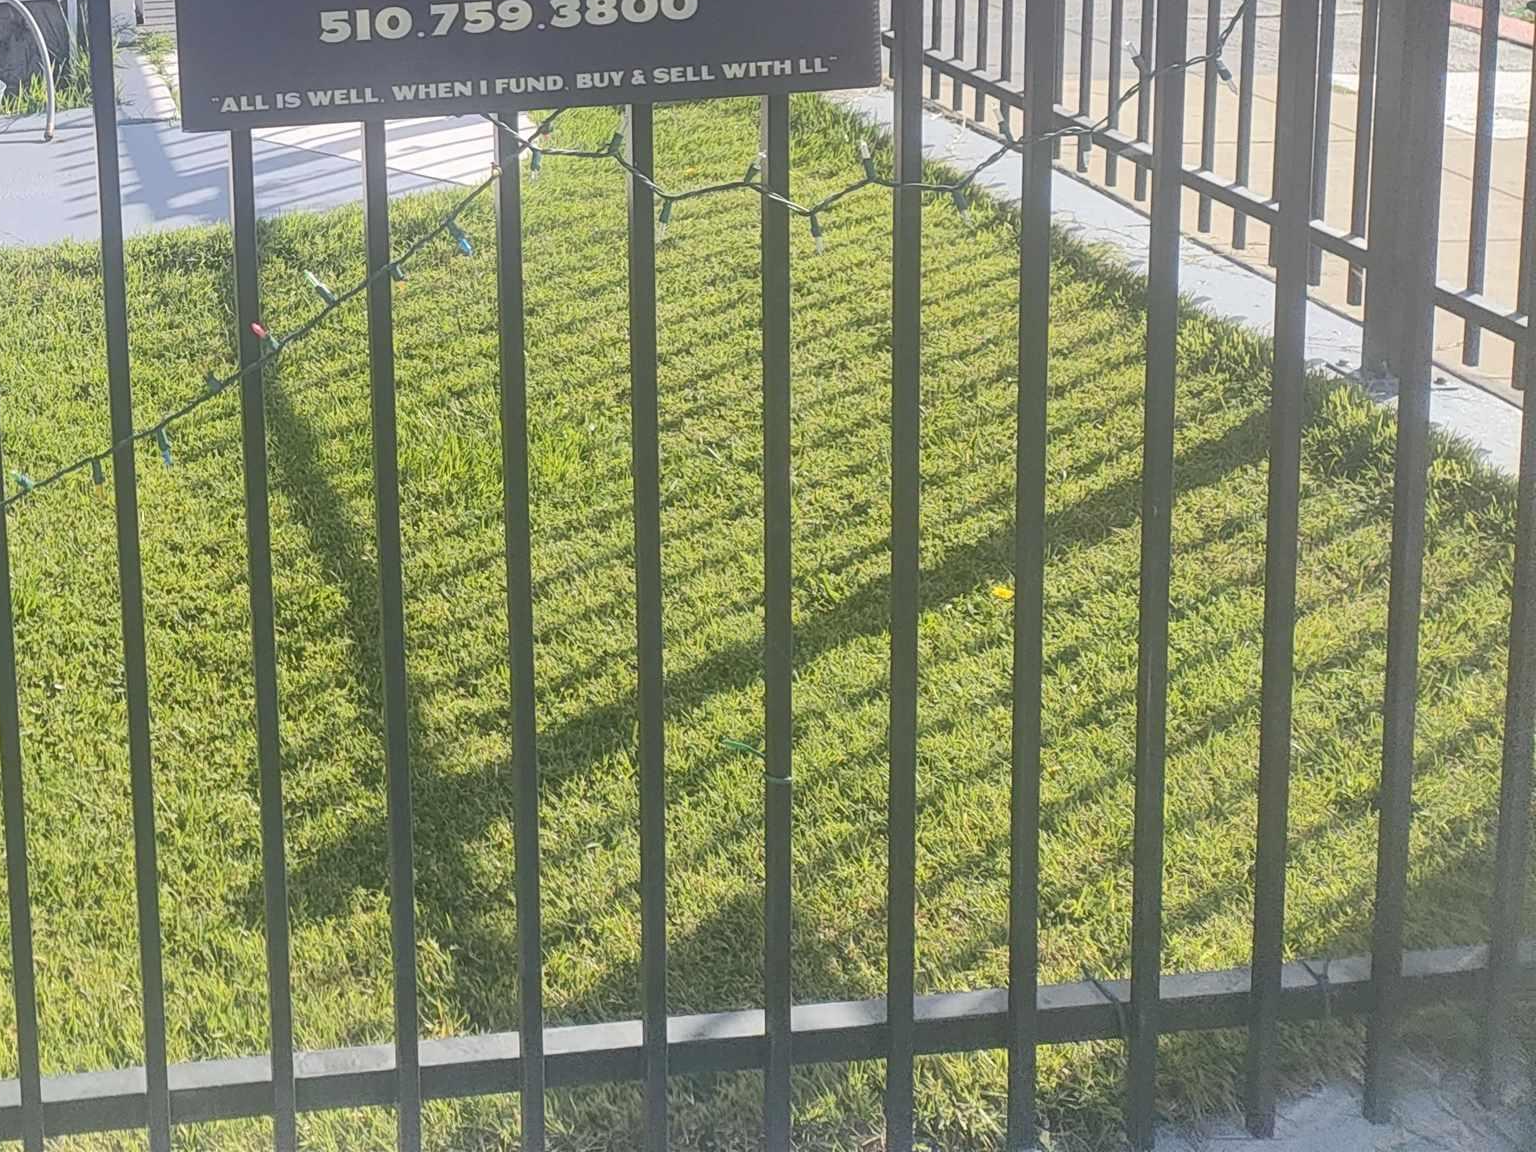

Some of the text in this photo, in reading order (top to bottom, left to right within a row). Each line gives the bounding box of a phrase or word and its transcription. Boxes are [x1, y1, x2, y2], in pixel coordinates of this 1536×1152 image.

[276, 91, 302, 109] IS
[391, 80, 473, 101] WHEN
[479, 79, 488, 96] I
[576, 70, 625, 89] BUY
[631, 69, 647, 85] &
[653, 65, 715, 84] SELL
[721, 59, 792, 79] WITH
